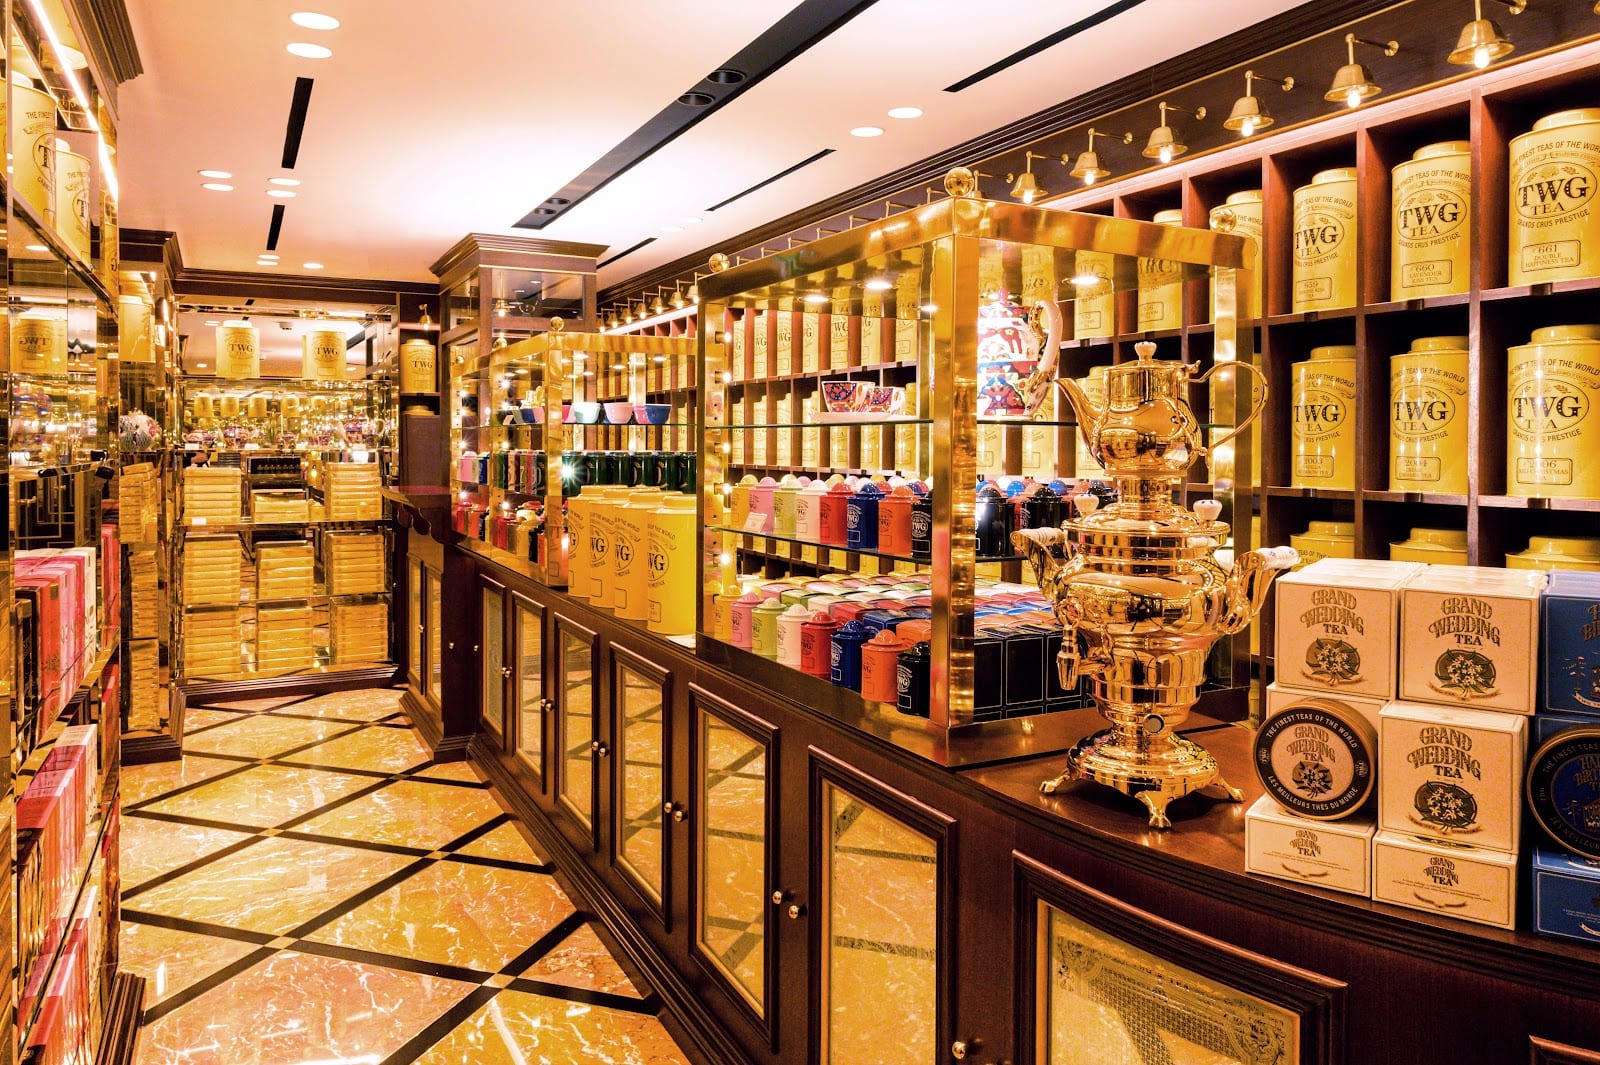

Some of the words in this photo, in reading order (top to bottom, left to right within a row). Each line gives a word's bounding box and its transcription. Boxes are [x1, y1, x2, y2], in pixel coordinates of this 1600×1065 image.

[1537, 142, 1554, 153] TEAS
[1555, 141, 1564, 149] OF
[1567, 140, 1582, 149] THE
[1415, 170, 1430, 179] TEAS
[1431, 169, 1440, 177] OF
[1440, 169, 1454, 178] THE
[1518, 176, 1590, 207] TWG
[1334, 197, 1353, 209] WORLD
[1530, 202, 1565, 215] TEA
[1399, 202, 1462, 229] TWG
[1536, 220, 1553, 229] CRUS
[1554, 208, 1590, 225] PRESTIGE
[1295, 225, 1340, 250] TWG
[1410, 225, 1440, 237] TEA
[1430, 231, 1461, 247] PRESTIGE
[1301, 246, 1321, 257] TEA
[229, 342, 253, 353] TWG
[316, 347, 339, 356] TWG
[411, 360, 433, 369] TWG
[1547, 358, 1556, 366] OF
[1559, 359, 1574, 368] THE
[1575, 361, 1600, 377] WORLD
[1335, 376, 1355, 389] WORLD
[1429, 367, 1442, 376] THE
[1443, 370, 1466, 384] WORLD
[1294, 404, 1341, 423] TWG
[1394, 401, 1449, 420] TWG
[1513, 395, 1582, 418] TWG
[1402, 421, 1428, 431] TEA
[1526, 419, 1557, 429] TA
[1547, 428, 1582, 442] PRESTIGE
[661, 528, 676, 541] WORLD
[1311, 589, 1357, 610] GRAND
[1441, 597, 1493, 620] GRAND
[1300, 606, 1364, 636] WEDDING
[1323, 623, 1349, 635] TEA
[1428, 615, 1500, 647] WEDDING
[1454, 633, 1483, 646] TEA
[1266, 726, 1276, 738] THE
[1275, 714, 1296, 729] FINEST
[1326, 719, 1339, 729] THE
[1338, 727, 1358, 749] WORLD
[1294, 725, 1330, 743] GRAND
[1419, 727, 1473, 752] GRAND
[1286, 739, 1336, 763] WEDDING
[1303, 752, 1323, 762] TEA
[1406, 745, 1481, 781] WEDDING
[1542, 759, 1555, 774] THE
[1552, 746, 1577, 763] FINEST
[1433, 765, 1464, 779] TEA
[1268, 775, 1279, 787] LES
[1277, 787, 1310, 809] MEILLEURS
[1339, 787, 1359, 805] MONDE
[1296, 829, 1319, 842] GRAND
[1298, 847, 1316, 857] TEA
[1430, 856, 1456, 870] GRAND
[1423, 866, 1459, 884] WEDDING
[1431, 875, 1453, 886] TEA
